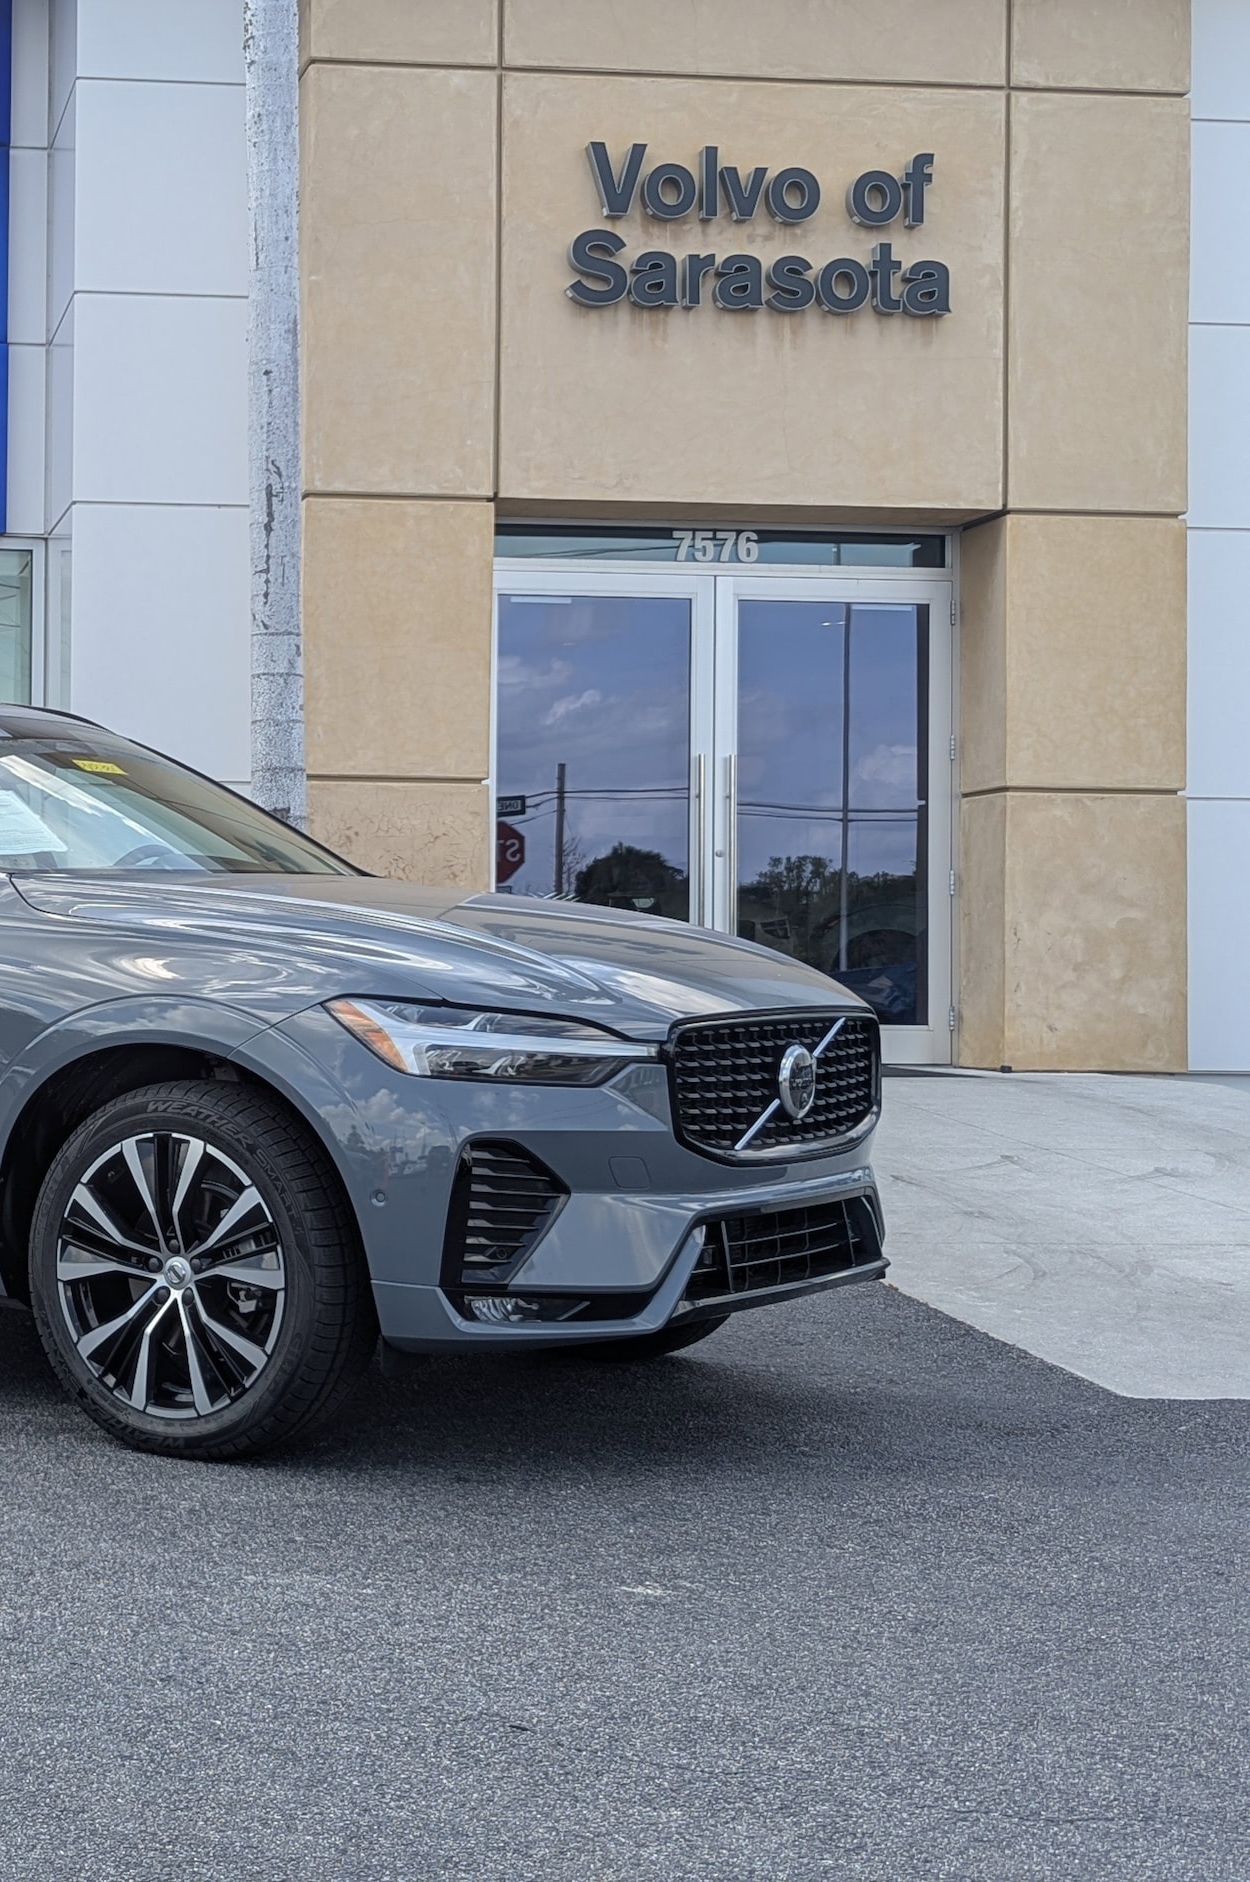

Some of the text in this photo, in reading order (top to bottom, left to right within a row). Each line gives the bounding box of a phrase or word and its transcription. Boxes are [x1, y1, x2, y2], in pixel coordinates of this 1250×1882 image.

[586, 140, 935, 229] Volvo of
[565, 228, 952, 317] Sarasota
[672, 530, 759, 563] 7576
[146, 1101, 300, 1217] WEATHER SMART
